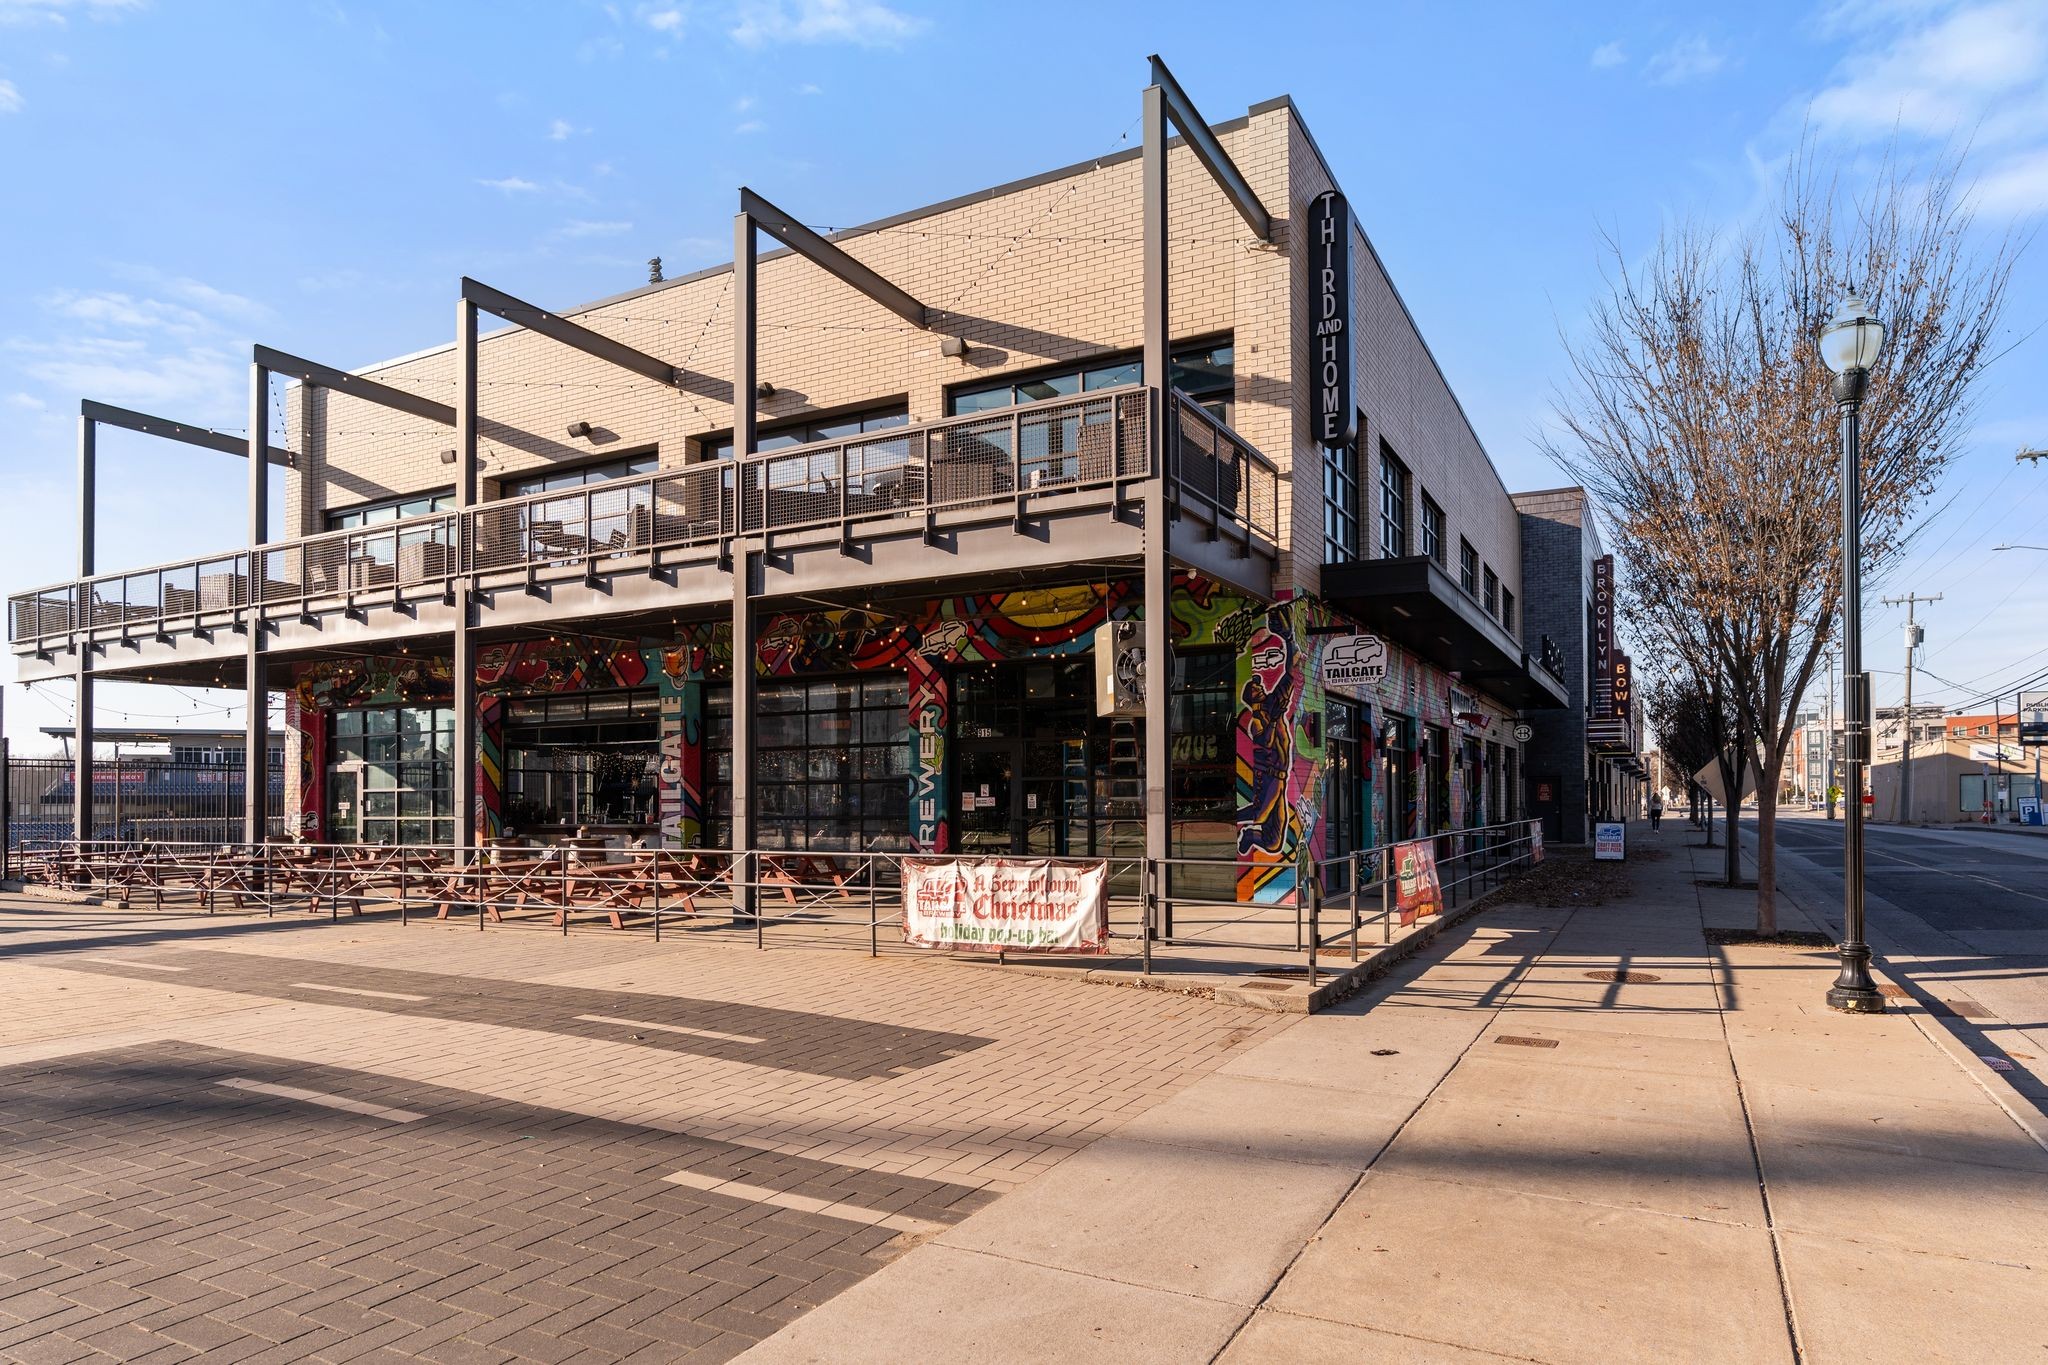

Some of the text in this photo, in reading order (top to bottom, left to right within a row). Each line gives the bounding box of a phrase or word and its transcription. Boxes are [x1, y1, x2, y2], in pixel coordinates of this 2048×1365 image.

[1321, 193, 1335, 318] THIRD
[1316, 318, 1342, 336] AND
[1322, 336, 1339, 439] HOME
[1597, 565, 1607, 670] BROOKLYN
[1325, 665, 1383, 679] TAILGATE
[1331, 676, 1377, 684] BREWERY
[1615, 663, 1628, 715] BOWL
[972, 875, 986, 893] A
[973, 893, 1079, 921] Christmas
[940, 922, 985, 941] holiday
[988, 927, 1034, 944] pop-up
